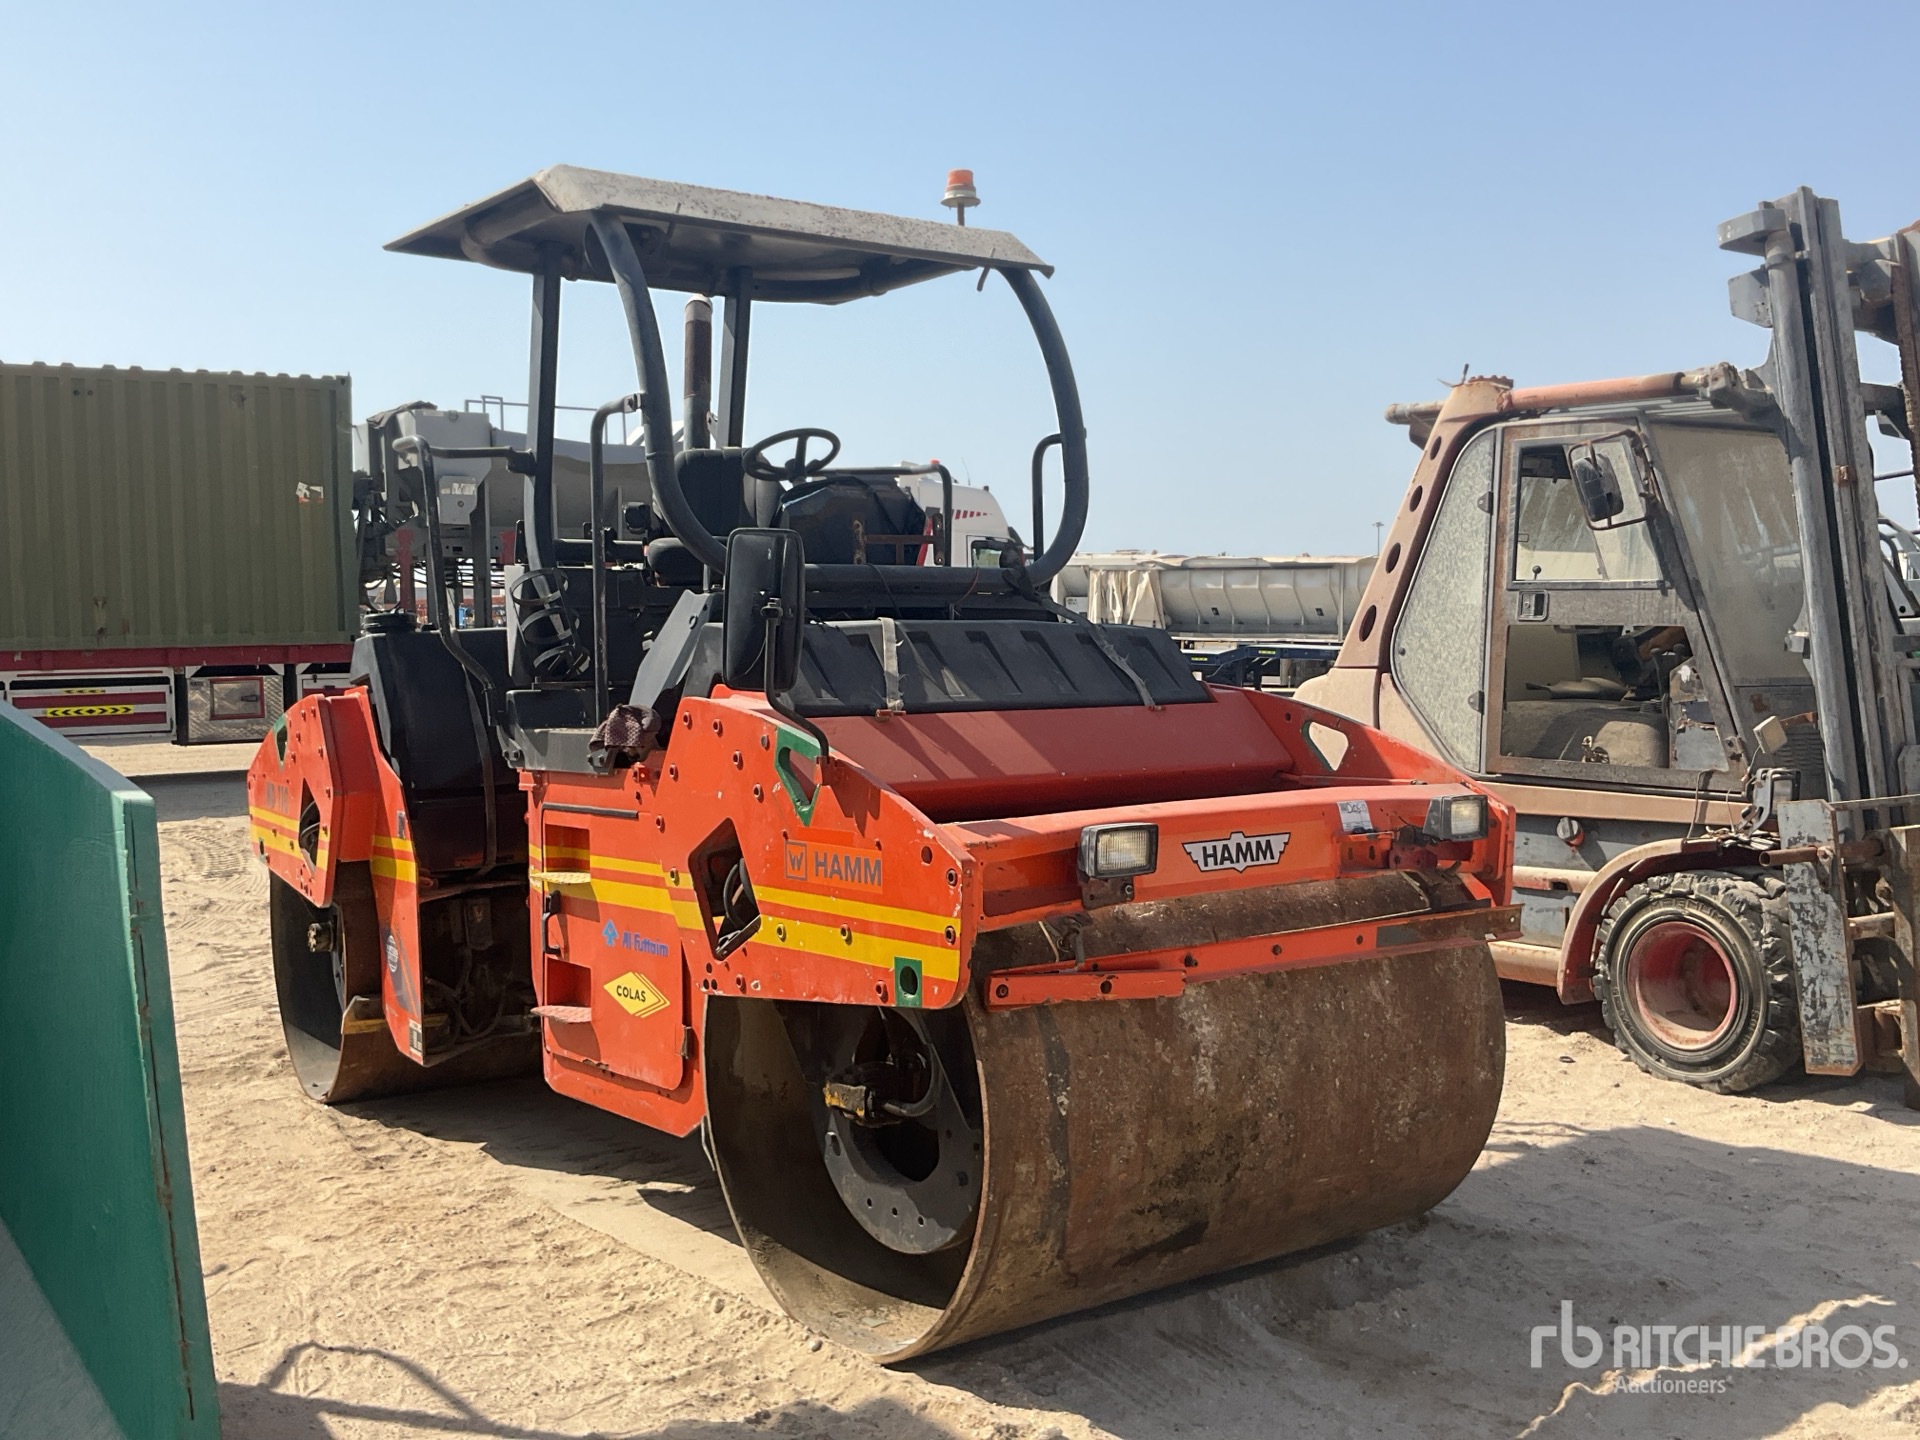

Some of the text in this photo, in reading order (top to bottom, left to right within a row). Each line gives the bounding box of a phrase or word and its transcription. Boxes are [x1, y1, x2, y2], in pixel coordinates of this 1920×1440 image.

[1202, 839, 1275, 867] HAMM
[814, 851, 882, 887] HAMM
[616, 985, 647, 1003] COLAS
